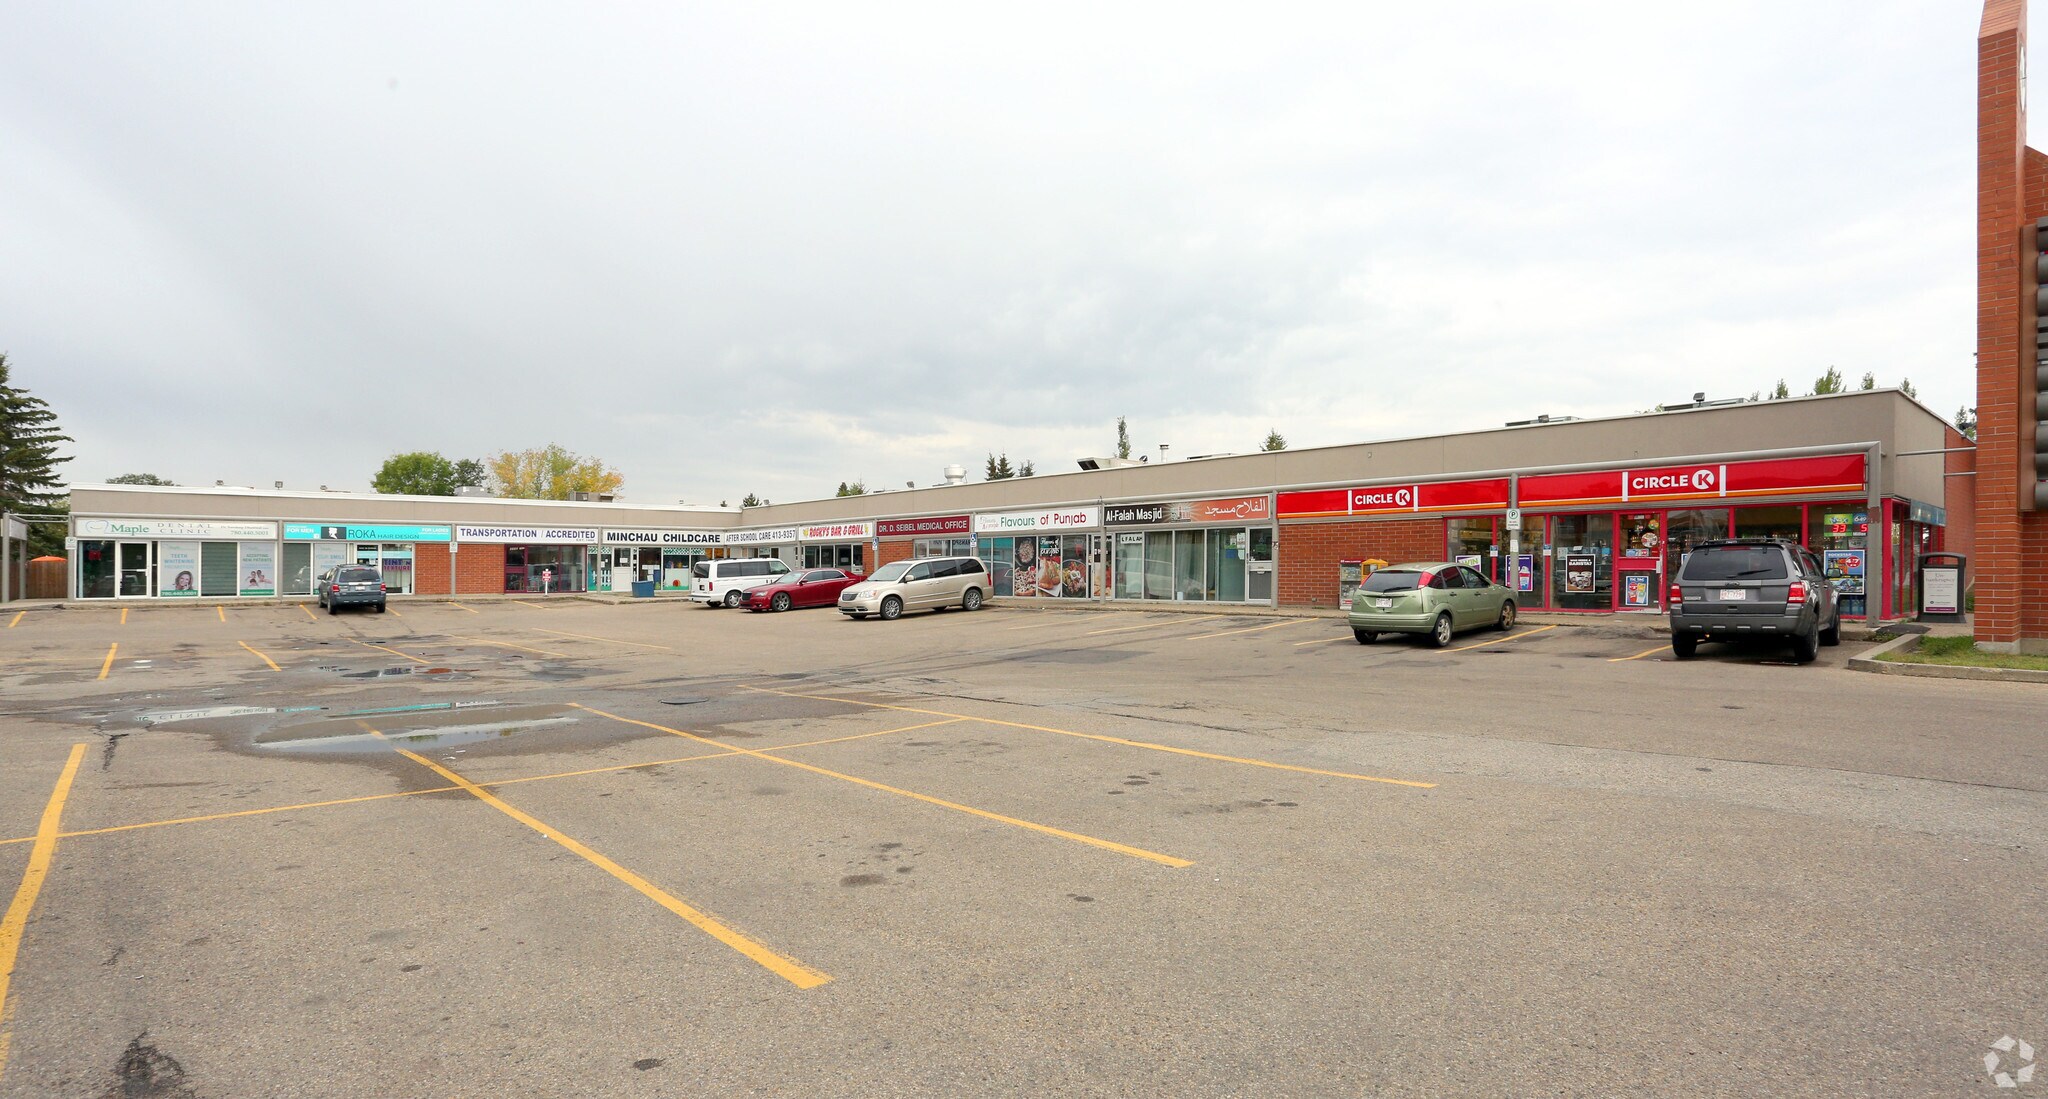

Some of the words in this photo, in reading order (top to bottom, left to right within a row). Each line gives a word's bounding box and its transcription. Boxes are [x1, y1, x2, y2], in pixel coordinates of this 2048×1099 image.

[1632, 475, 1688, 489] CIRCLE
[1696, 472, 1711, 487] K
[1355, 494, 1393, 505] CIRCLE
[1397, 491, 1409, 504] K
[1205, 505, 1236, 517] مسجد
[1236, 498, 1266, 518] الفلاح
[1001, 516, 1035, 528] Flavours
[1040, 514, 1049, 525] of
[1054, 512, 1087, 526] Punjab
[1106, 509, 1135, 522] Al-Falah
[1136, 507, 1162, 522] Masjid
[110, 524, 150, 536] Maple
[809, 527, 830, 538] ROCKY'S
[831, 526, 842, 537] BAR
[848, 524, 864, 535] GRILL
[896, 523, 916, 531] SEIBEL
[917, 522, 943, 531] MEDICAL
[944, 520, 967, 529] OFFICE
[1832, 524, 1847, 533] 33
[348, 529, 376, 539] ROKA
[460, 528, 537, 538] TRANSPORTATION
[545, 530, 596, 539] ACCREDITED
[607, 532, 658, 542] MINCHAU
[663, 533, 721, 543] CHILDCARE
[726, 533, 740, 542] AFTER
[740, 533, 757, 542] SCHOOL
[758, 532, 771, 540] CARE
[772, 530, 796, 539] 413-9357
